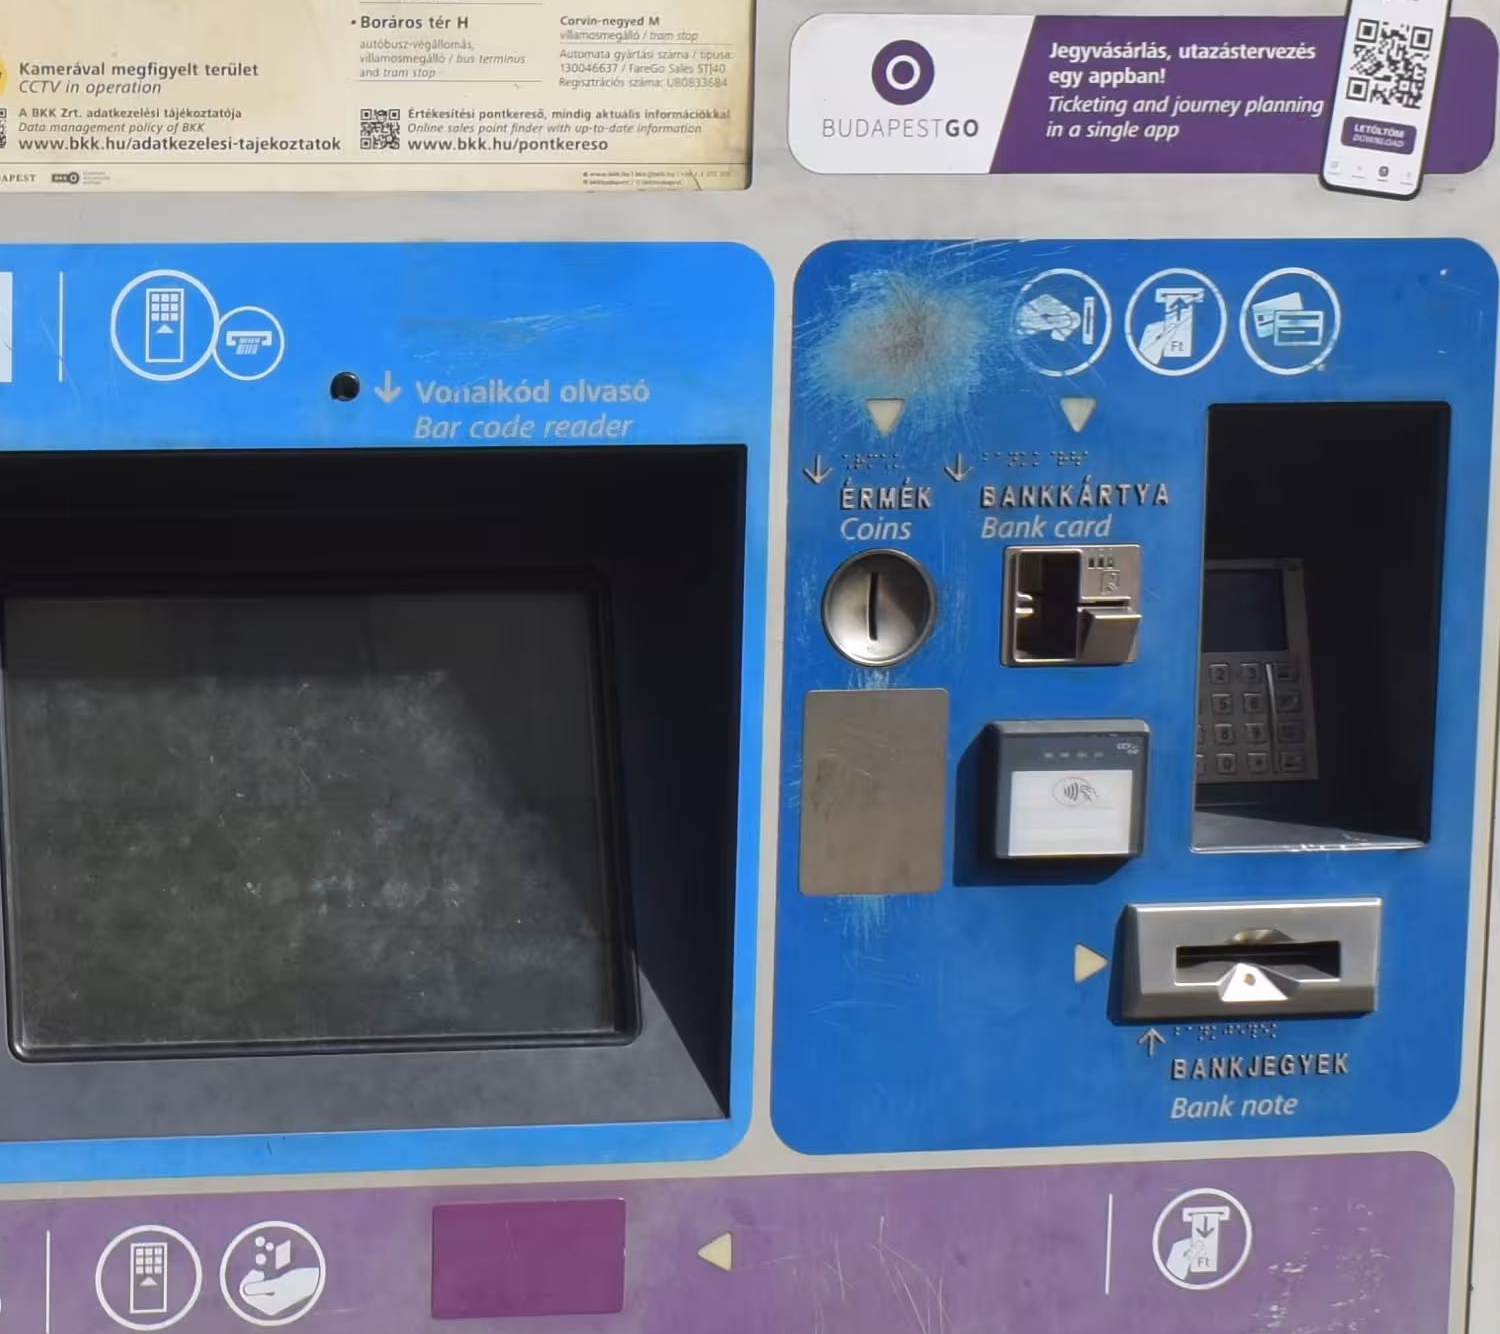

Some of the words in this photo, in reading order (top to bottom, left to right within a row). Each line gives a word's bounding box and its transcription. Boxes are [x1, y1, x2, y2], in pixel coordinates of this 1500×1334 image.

[360, 14, 422, 29] Boráros
[428, 15, 451, 29] tér
[457, 16, 468, 29] H
[1049, 41, 1172, 63] Jegyvásárlás,
[1178, 42, 1316, 59] utazástervezés
[19, 61, 105, 75] Kamerával
[111, 61, 198, 80] megfigyelt
[204, 62, 258, 76] terület
[1048, 70, 1083, 88] egy
[1088, 67, 1166, 87] appban!
[18, 79, 61, 93] CCTV
[65, 79, 80, 93] in
[85, 80, 161, 96] operation
[18, 107, 27, 117] A
[32, 107, 56, 117] BKK
[60, 107, 82, 118] Zrt.
[86, 107, 159, 118] adatkezelési
[164, 107, 242, 120] tájékoztatója
[1048, 95, 1128, 117] Ticketing
[1132, 95, 1170, 112] and
[1168, 95, 1242, 117] journey
[1244, 95, 1324, 117] planning
[18, 121, 46, 132] Data
[49, 123, 126, 135] management
[128, 122, 163, 135] policy
[166, 121, 179, 135] of
[182, 122, 205, 132] BKK
[407, 122, 444, 133] Online
[447, 122, 474, 133] sales
[477, 122, 507, 135] point
[510, 122, 543, 135] finder
[547, 123, 571, 133] with
[574, 123, 634, 135] up-to-date
[636, 123, 702, 135] information
[822, 118, 979, 137] BUDAPESTGO
[1045, 120, 1064, 137] in
[1068, 124, 1081, 137] a
[1085, 120, 1139, 142] single
[1144, 124, 1180, 141] app
[18, 136, 340, 152] www.bkk.hu/adatkezelesi-tajekoztatok
[407, 136, 608, 152] www.bkk.hu/pontkereso
[415, 378, 549, 403] Vonalkód
[560, 378, 650, 402] olvasó
[414, 416, 462, 438] Bar
[469, 414, 535, 438] code
[543, 414, 633, 437] reader
[840, 477, 933, 510] ÉRMÉK
[981, 474, 1170, 509] BANKKÁRTYA
[840, 517, 912, 541] Coins
[981, 514, 1048, 538] Bank
[1054, 513, 1112, 538] card
[1170, 1050, 1350, 1083] BANKJEGYEK
[1170, 1094, 1234, 1118] Bank
[1240, 1095, 1298, 1116] note
